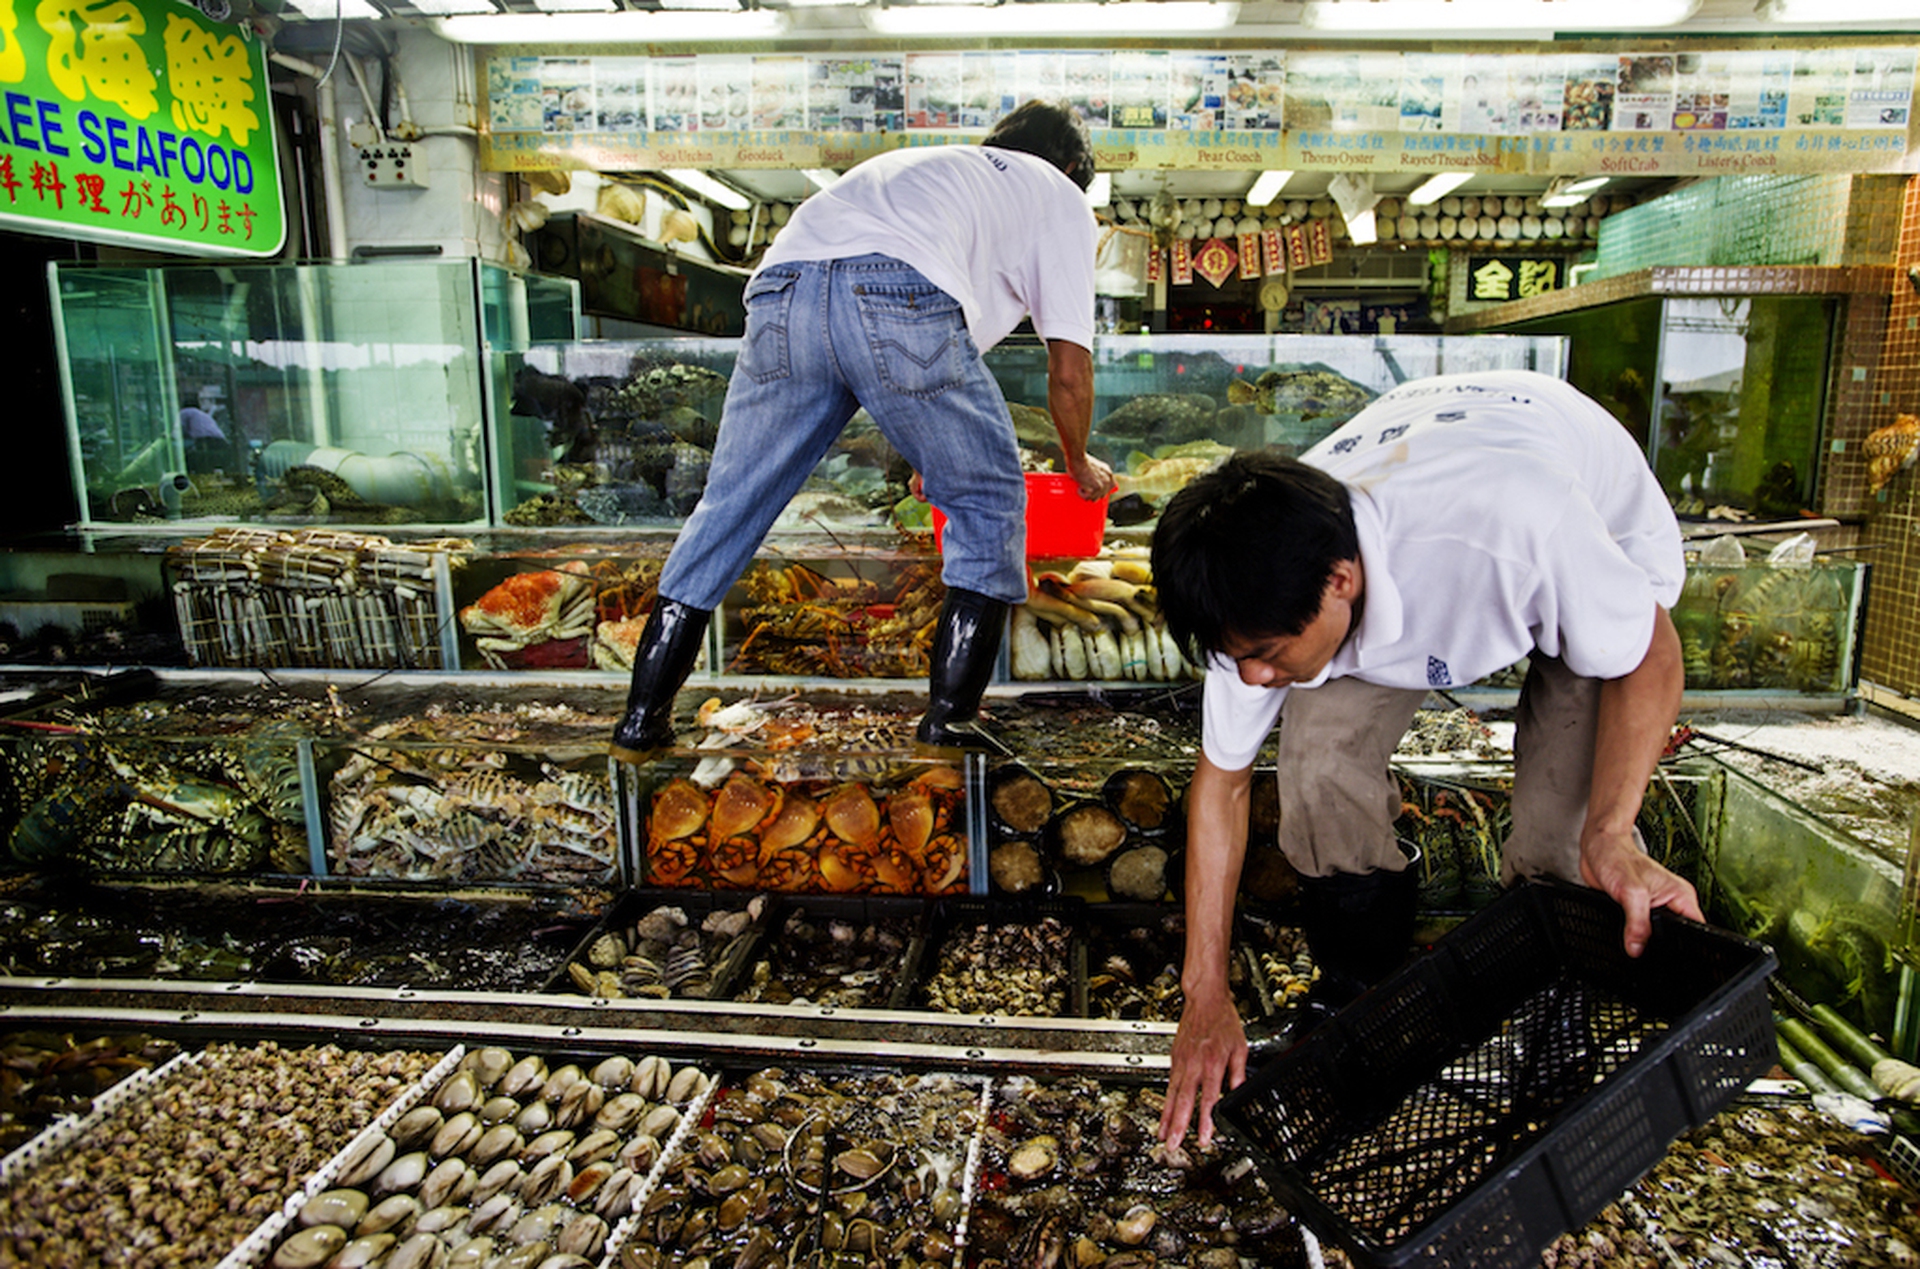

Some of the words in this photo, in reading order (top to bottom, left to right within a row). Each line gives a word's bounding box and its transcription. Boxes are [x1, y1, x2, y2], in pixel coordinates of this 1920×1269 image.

[0, 0, 259, 147] 海鮮
[0, 90, 70, 158] EE
[78, 109, 254, 195] SEAFOOD
[1197, 149, 1224, 163] Pear
